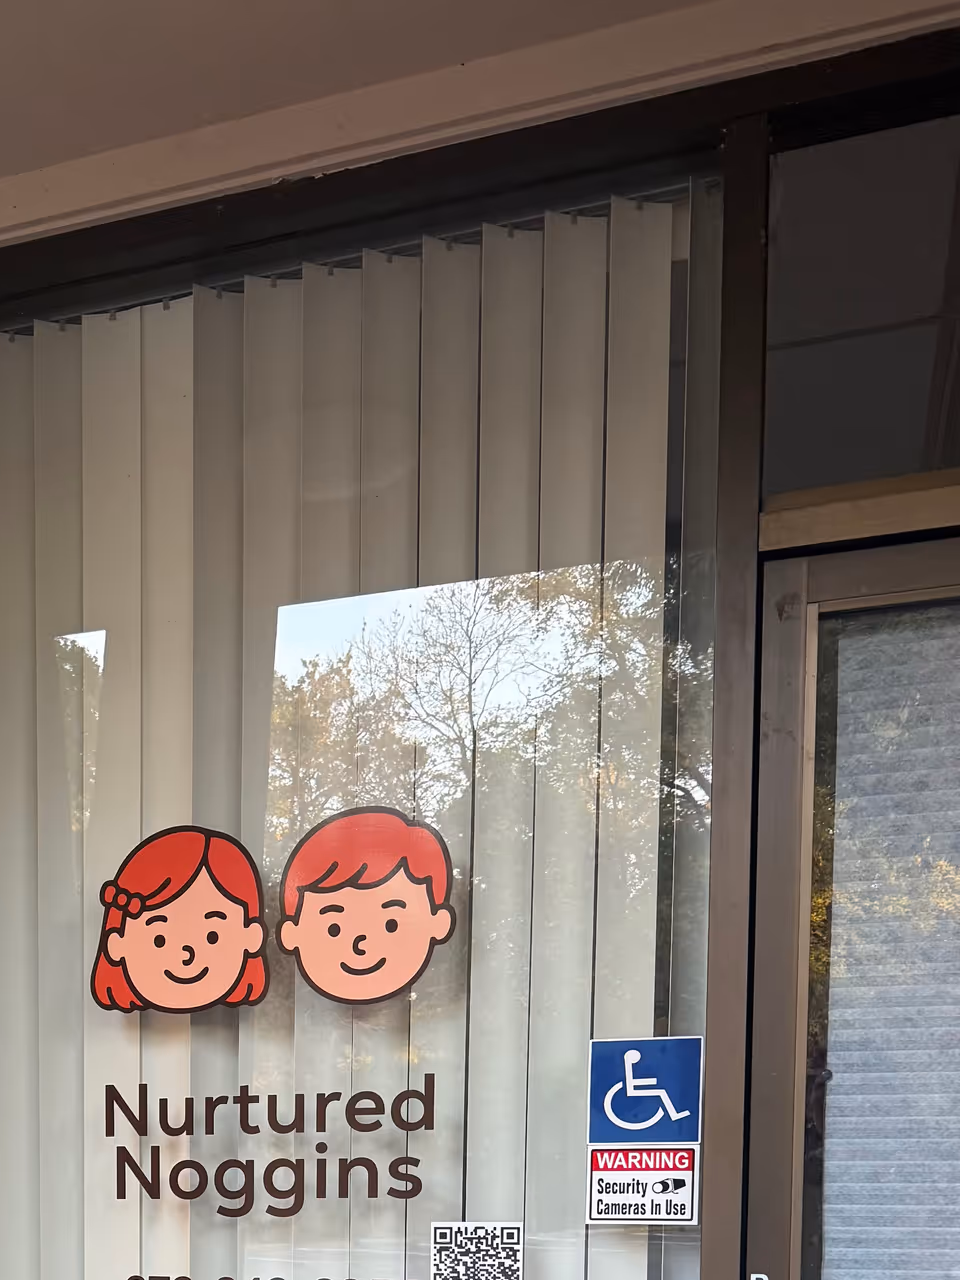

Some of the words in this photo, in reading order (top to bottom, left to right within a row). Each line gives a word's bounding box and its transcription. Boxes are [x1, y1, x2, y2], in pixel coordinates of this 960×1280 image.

[105, 1073, 435, 1137] Nurtured
[596, 1152, 689, 1169] WARNING
[116, 1142, 423, 1218] Noggins
[597, 1178, 648, 1198] Security
[596, 1199, 646, 1215] Cameras
[651, 1199, 661, 1215] In
[665, 1199, 686, 1216] Use
